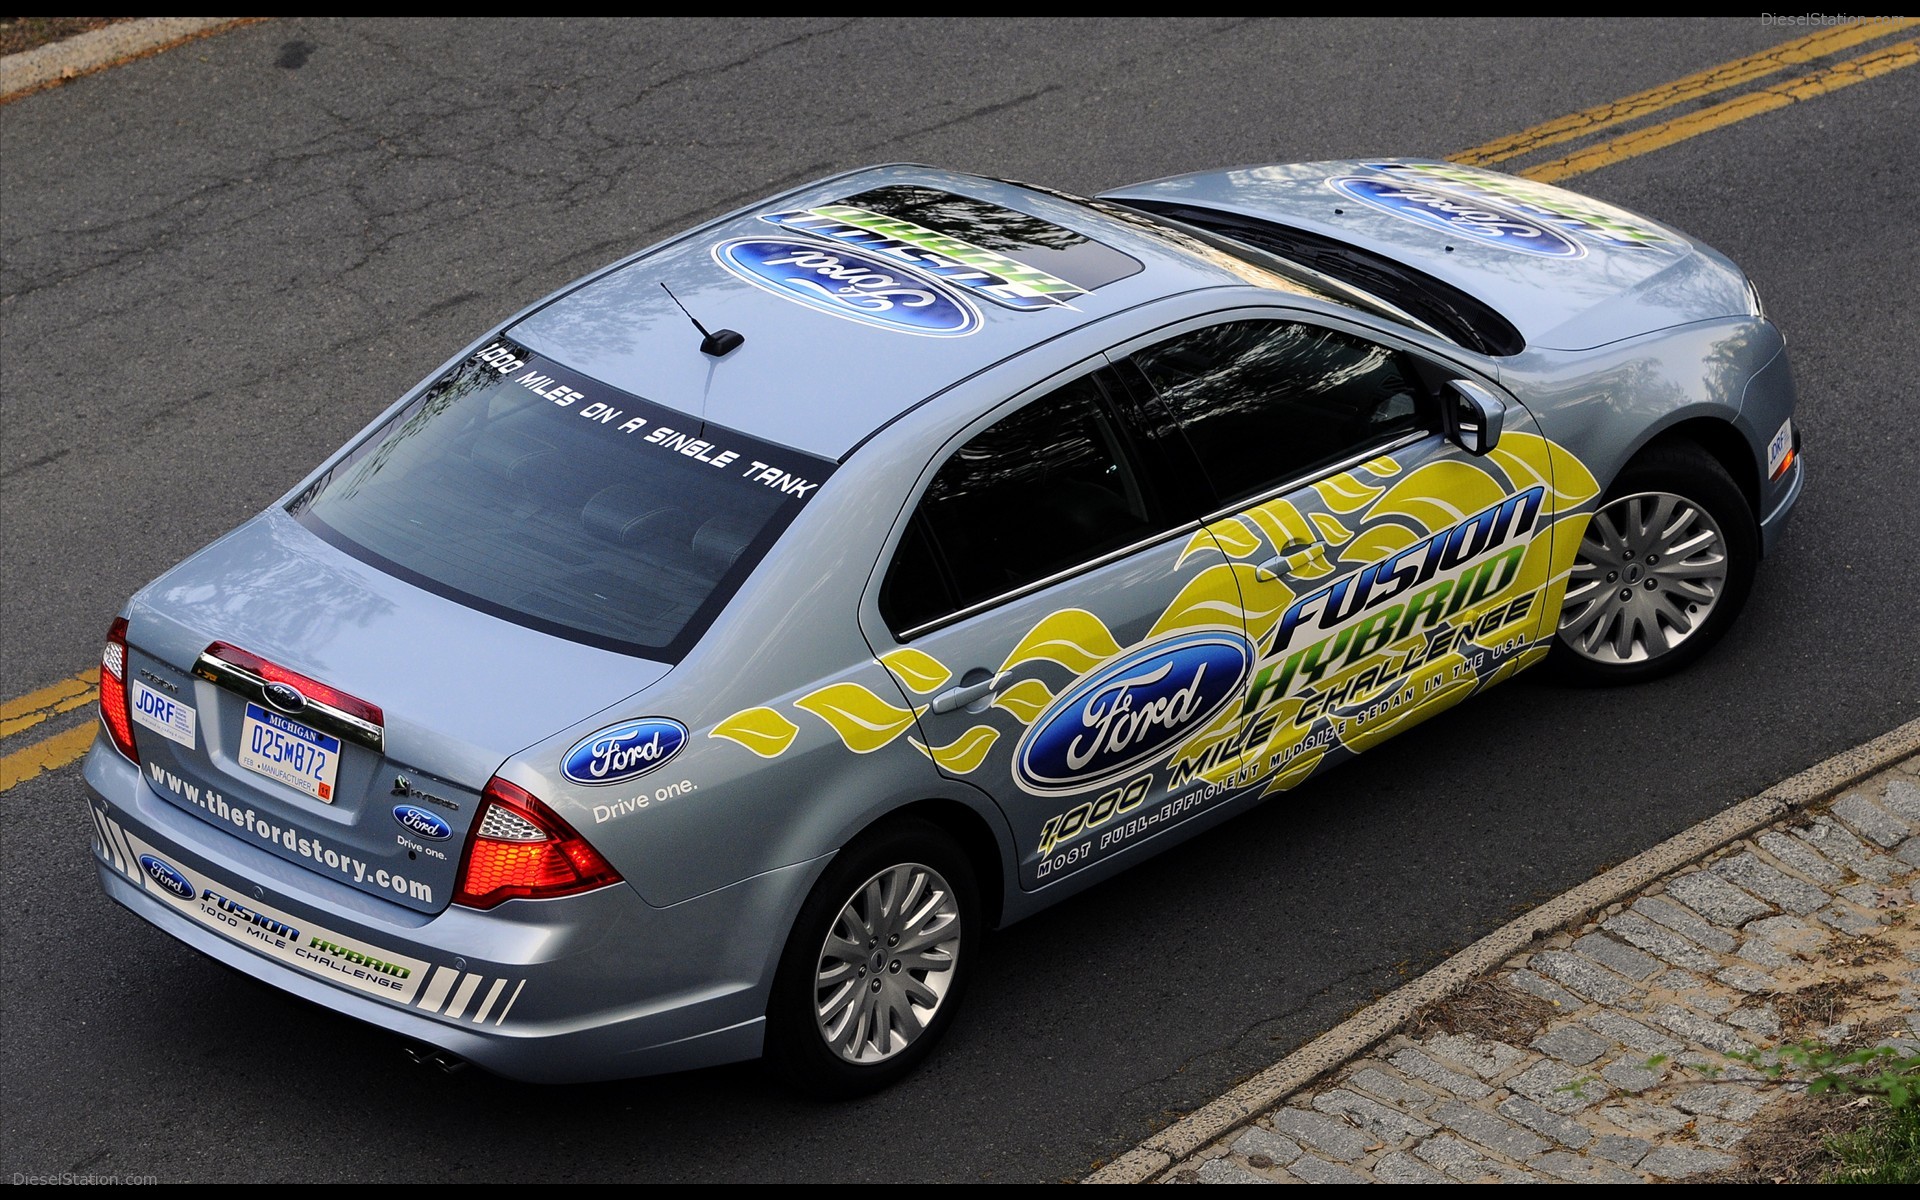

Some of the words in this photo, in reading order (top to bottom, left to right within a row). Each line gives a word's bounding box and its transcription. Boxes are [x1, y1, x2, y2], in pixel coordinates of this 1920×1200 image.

[1375, 189, 1542, 238] Ford
[761, 250, 937, 312] Ford
[514, 370, 585, 407] MILES
[579, 402, 623, 424] ON
[618, 416, 647, 435] A
[643, 426, 741, 469] SINGLE
[742, 460, 819, 499] TANK
[1262, 485, 1546, 658] FUSION
[1242, 543, 1528, 714] HYBRID
[135, 689, 175, 723] JDRF
[1066, 660, 1204, 771] Ford
[1167, 711, 1278, 793] MILE
[1294, 590, 1539, 729] CHALLENGE
[251, 724, 326, 781] 025M872
[269, 714, 318, 742] MICHIGAN
[590, 729, 664, 778] Ford
[243, 756, 255, 767] FEB
[261, 763, 312, 791] MANUFACTURER
[1037, 841, 1093, 879] MOST
[1100, 763, 1260, 850] FUEL-EFFICIENT
[1268, 721, 1346, 769] MIDSIZE
[1356, 688, 1414, 726] SEDAN
[1424, 673, 1443, 694] IN
[1453, 651, 1485, 679] THE
[1492, 633, 1526, 660] USA
[320, 785, 329, 796] 11
[592, 794, 650, 824] Drive
[655, 779, 698, 802] one.
[149, 762, 433, 903] www.thefordstory.com
[397, 835, 423, 852] Drive
[425, 847, 448, 861] one.
[402, 808, 440, 836] Ford
[149, 860, 184, 895] Ford
[200, 888, 301, 942] FUSION
[310, 936, 412, 981] HYBRID
[246, 927, 287, 950] MILE
[295, 948, 404, 992] CHALLENGE
